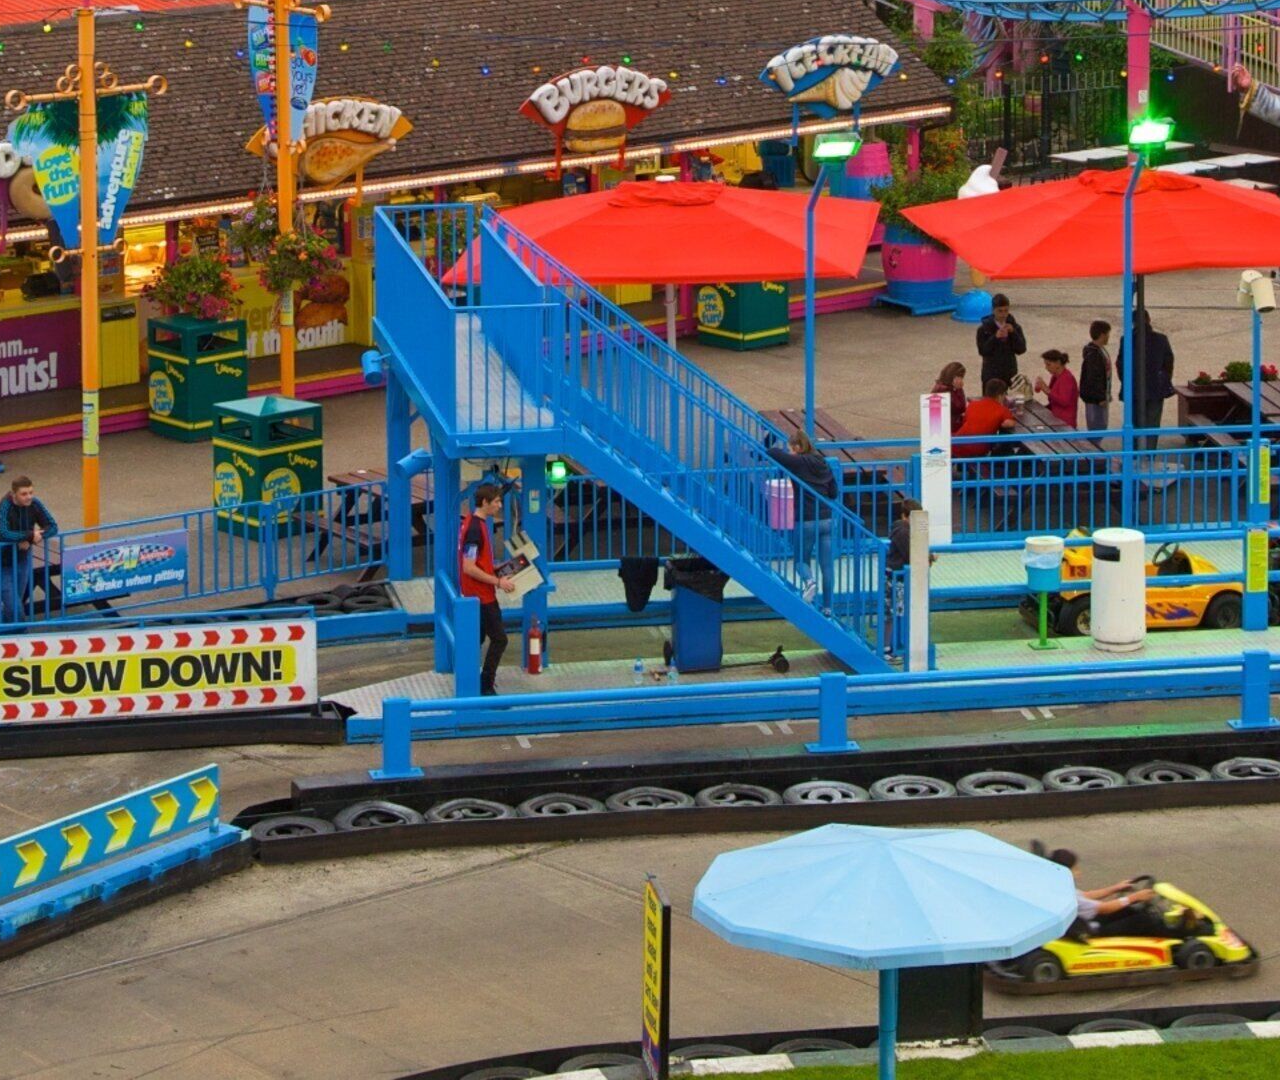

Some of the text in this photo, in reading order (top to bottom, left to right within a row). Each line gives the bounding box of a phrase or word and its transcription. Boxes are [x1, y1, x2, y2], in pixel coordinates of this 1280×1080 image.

[767, 34, 900, 92] ICE CREAM
[530, 66, 668, 124] BURGERS
[304, 98, 403, 139] HICKEN
[37, 152, 73, 172] Love
[49, 168, 74, 183] the
[100, 128, 131, 231] adventure
[121, 131, 145, 189] island
[296, 318, 345, 350] south
[95, 568, 185, 593] brake when pitting
[1069, 564, 1090, 579] 13
[2, 649, 283, 698] SLOW DOWN!
